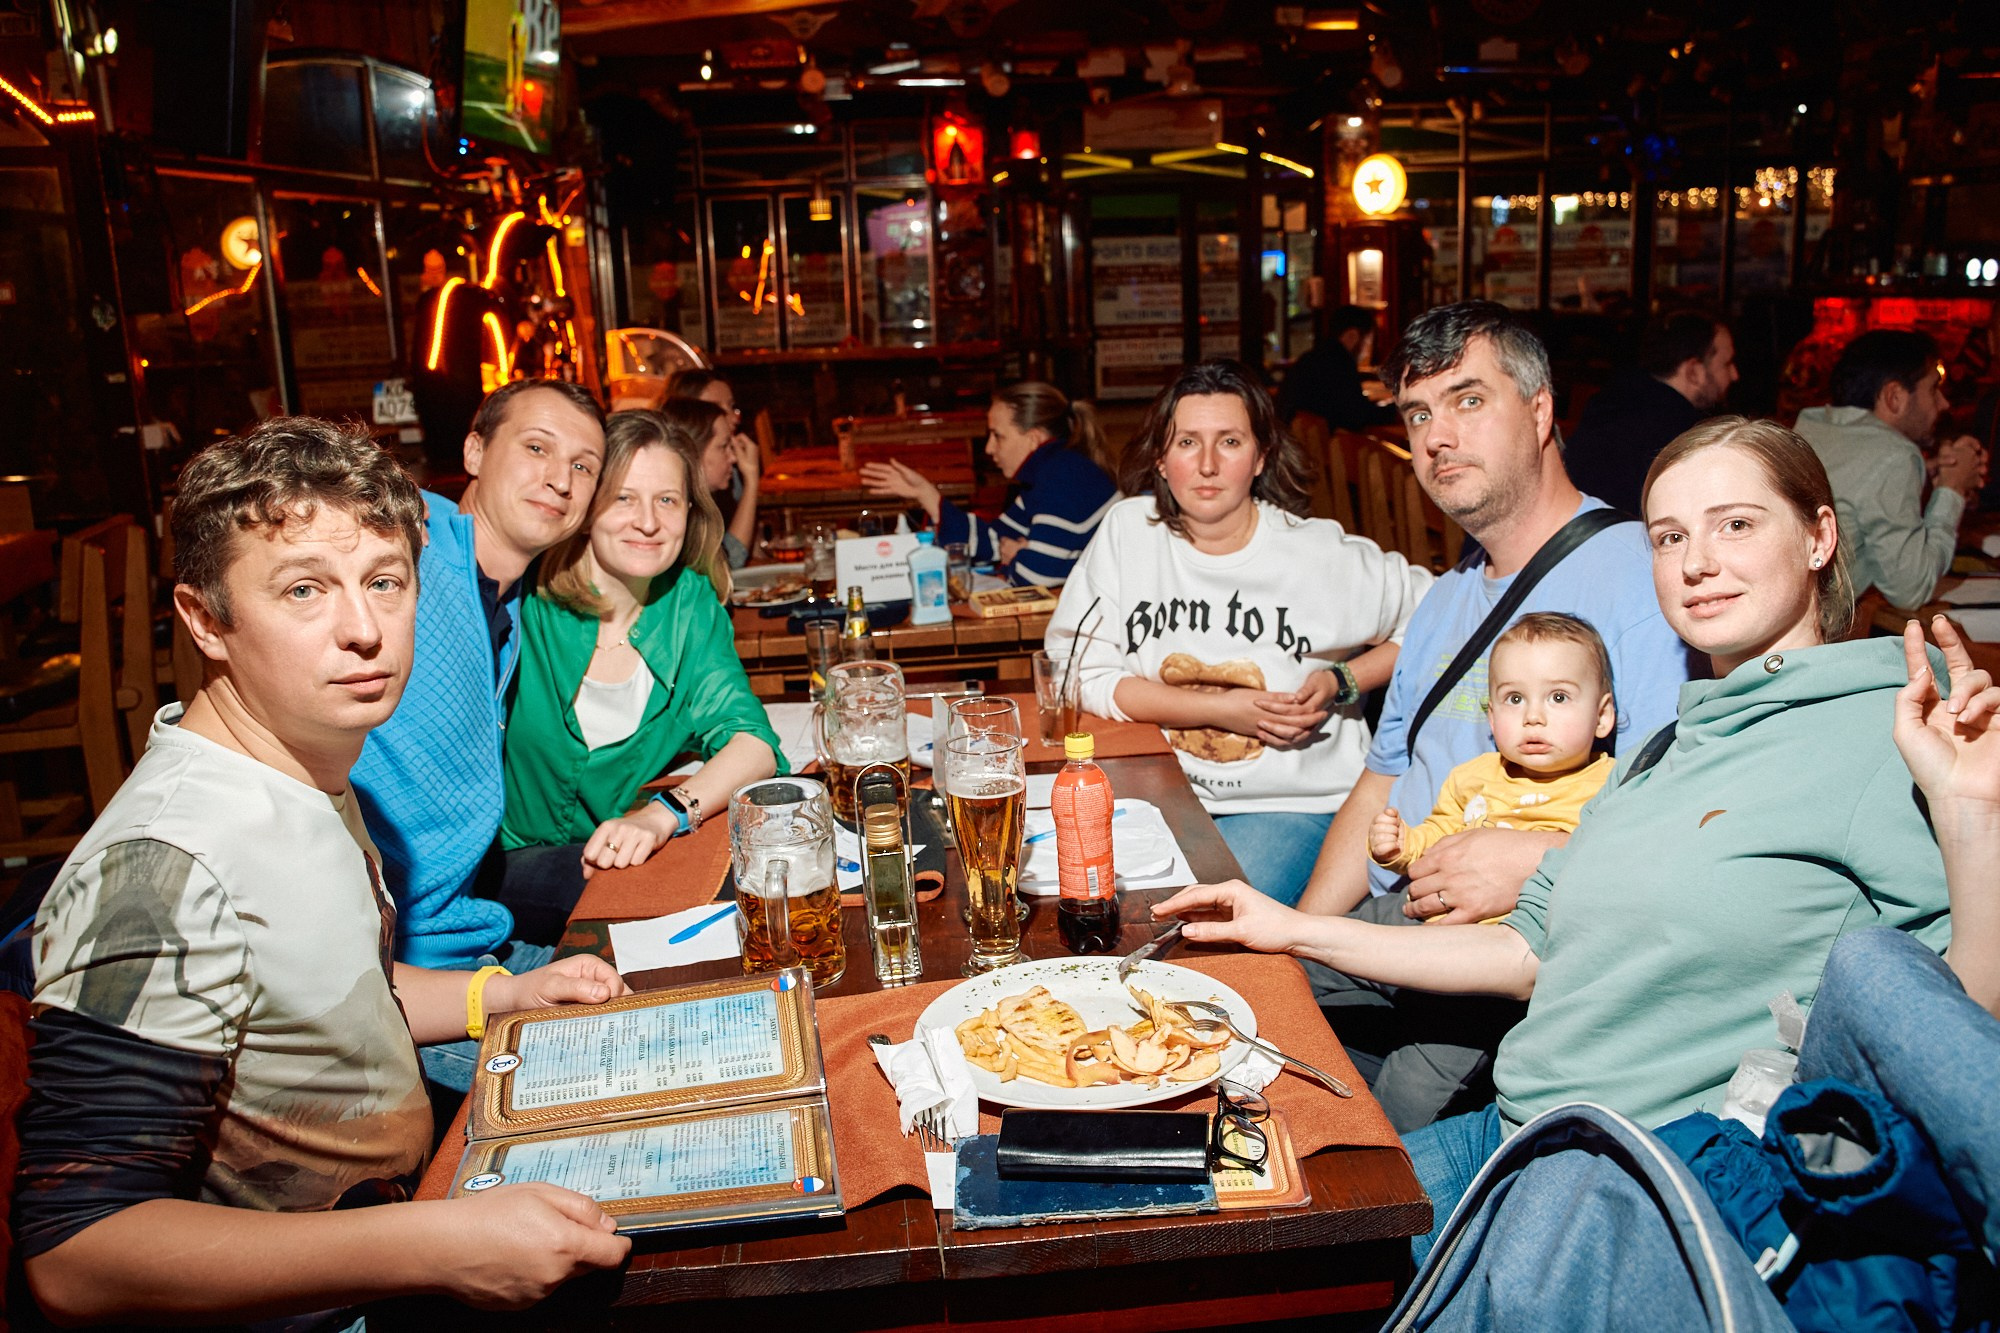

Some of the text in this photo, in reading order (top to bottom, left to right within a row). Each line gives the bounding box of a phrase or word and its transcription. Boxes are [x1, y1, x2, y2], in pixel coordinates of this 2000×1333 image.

[854, 563, 878, 571] Место
[1125, 596, 1211, 656] Born
[1225, 590, 1264, 643] to
[769, 1018, 778, 1041] ЗАКУСКИ
[605, 1037, 614, 1088] ПРИГОТОВЛЕННЫЕ
[607, 1154, 617, 1176] ДЕСЕРТЫ
[645, 1151, 653, 1170] САЛАТЫ
